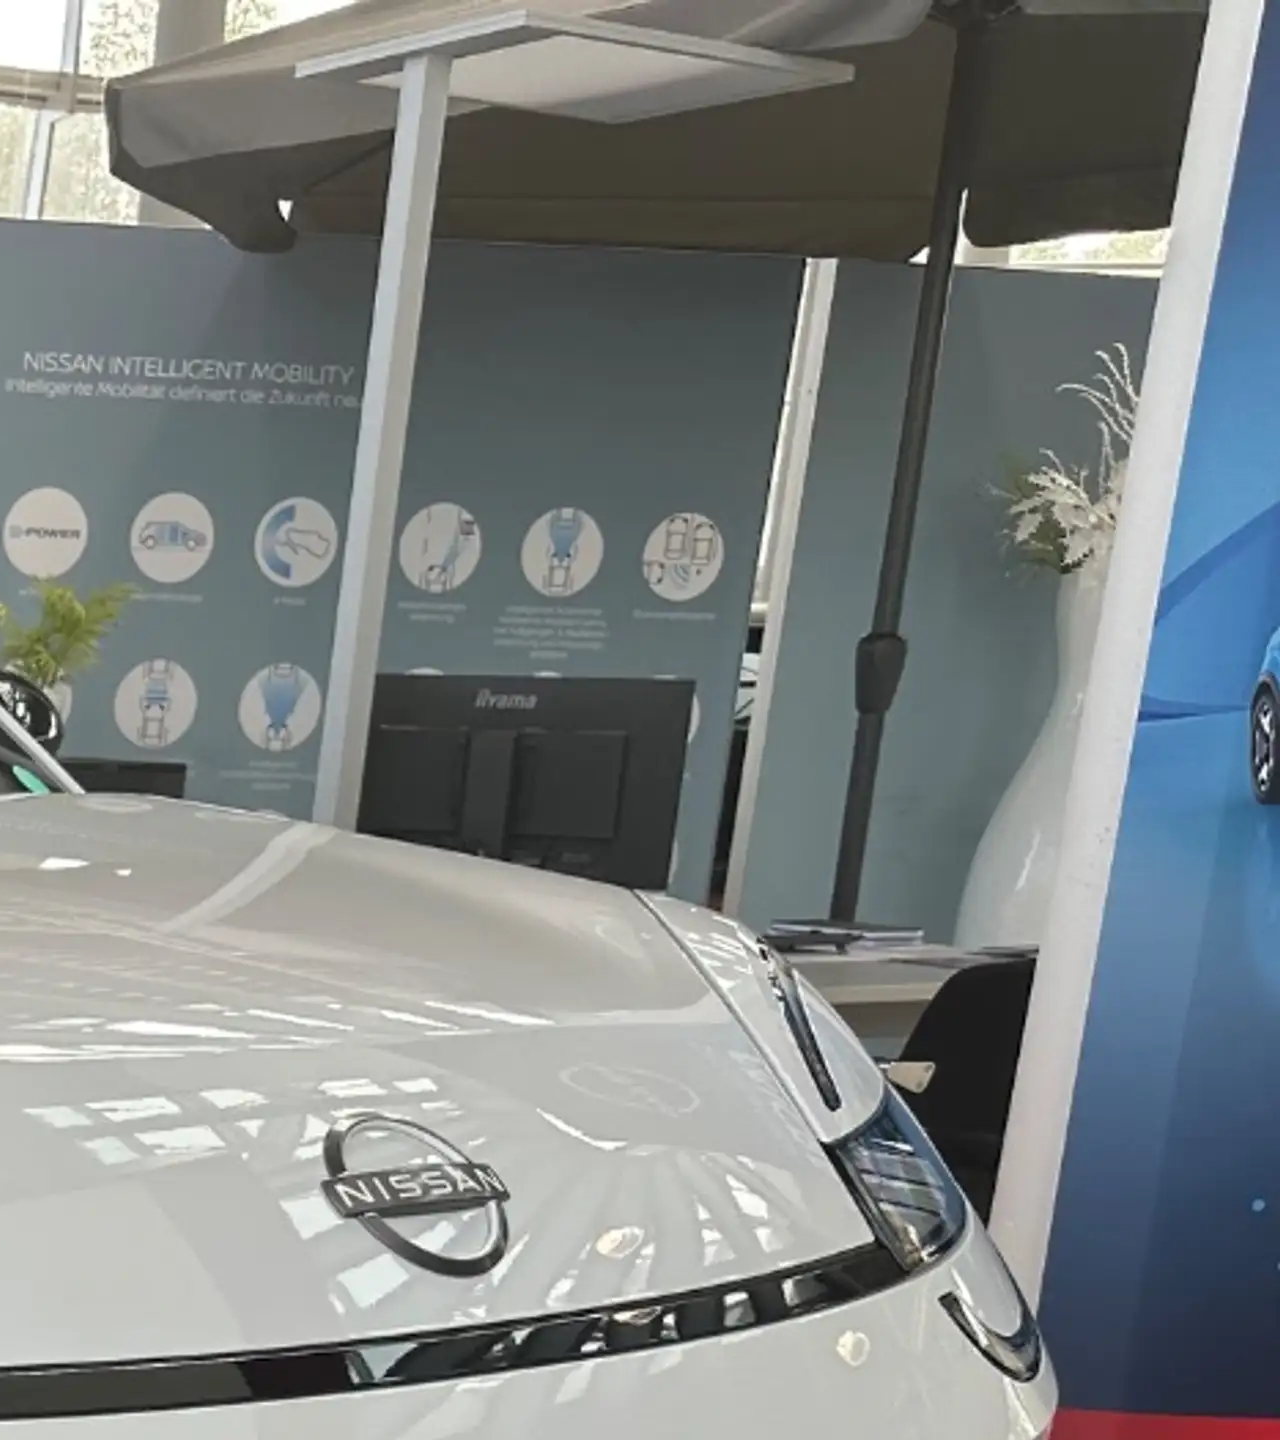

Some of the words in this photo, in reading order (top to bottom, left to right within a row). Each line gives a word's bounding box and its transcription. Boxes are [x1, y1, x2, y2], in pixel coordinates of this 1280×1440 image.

[23, 352, 105, 375] NISSAN
[109, 356, 247, 380] INTELLIGENT
[250, 361, 356, 386] MOBILITY
[333, 1165, 505, 1208] NISSAN
